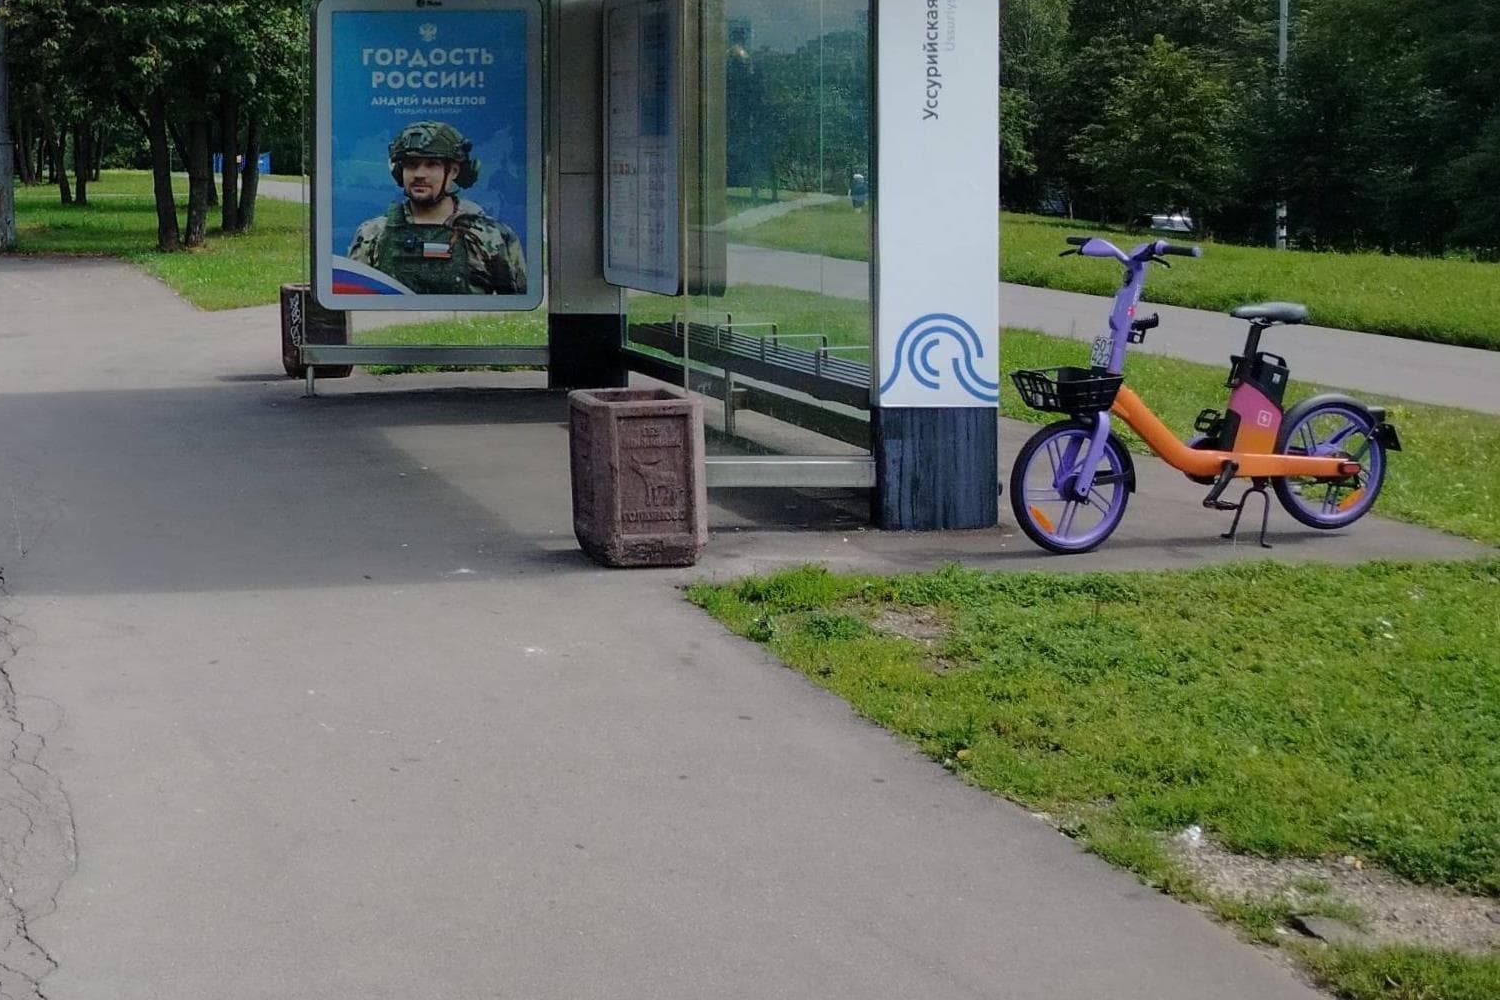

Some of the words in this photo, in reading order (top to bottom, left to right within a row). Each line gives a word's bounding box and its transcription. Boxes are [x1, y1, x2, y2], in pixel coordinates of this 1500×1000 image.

[361, 47, 495, 68] ГОРДОСТЬ
[371, 70, 486, 89] РОССИИ!
[370, 94, 420, 106] АНДРЕЙ
[421, 95, 487, 106] МАРКЕЛОВ
